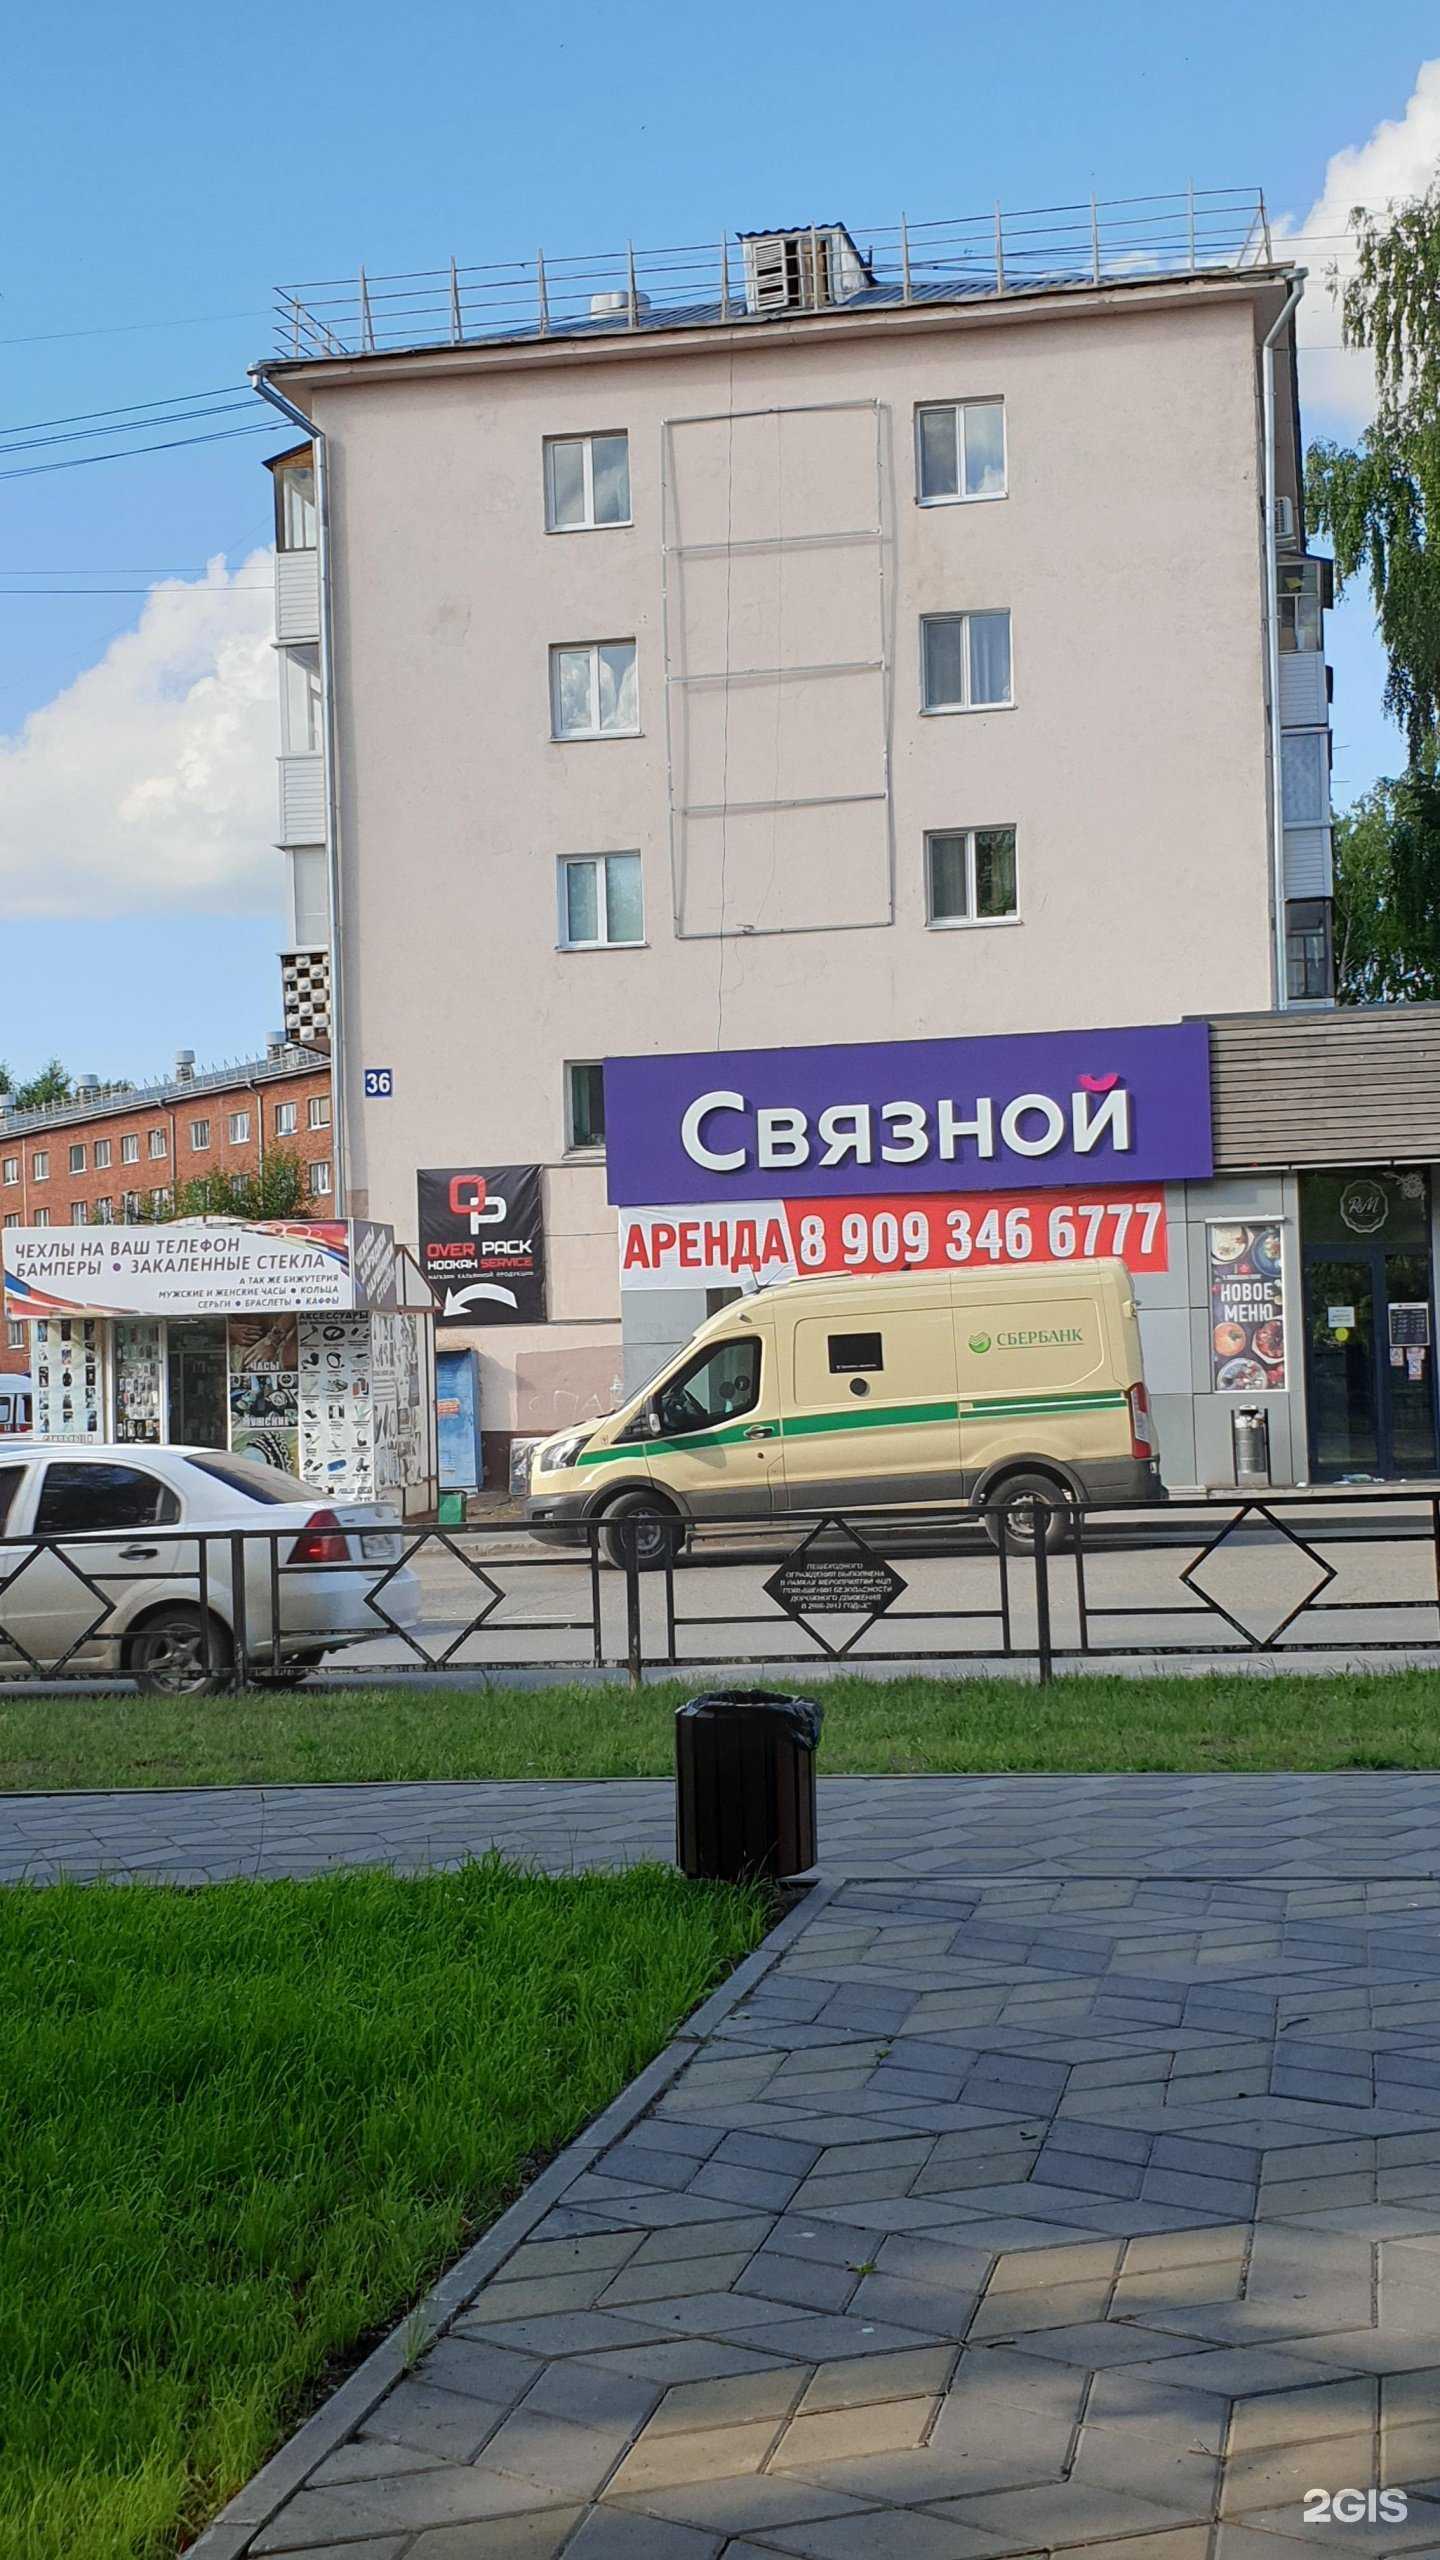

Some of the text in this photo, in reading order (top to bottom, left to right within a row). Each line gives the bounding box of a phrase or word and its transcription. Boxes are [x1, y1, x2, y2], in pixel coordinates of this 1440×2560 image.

[366, 1072, 391, 1094] 36
[622, 1201, 1163, 1274] АРЕНДА 8 909 346 6777
[15, 1237, 240, 1259] ЧЕХЛЫ НА ВАШ ТЕЛЕФОН
[426, 1239, 533, 1258] OVER PACK
[16, 1253, 326, 1278] БАМПЕРЫ ЗАКАЛЕННЫЕ СТЕКЛА
[427, 1256, 533, 1271] HOOKAH SERVICE
[239, 1273, 339, 1285] А ТАК ЖЕ БИЖУТЕРИЯ
[158, 1285, 339, 1299] МУЖСКИЕ И ЖЕНСКИЕ ЧАСЫ КОЛЬЦА
[1220, 1282, 1274, 1302] НОВОЕ
[198, 1296, 340, 1309] СЕРЬГИ БРАСЛЕТЫ КАФФЫ
[298, 1311, 369, 1321] АКСЕССУАРЫ
[1223, 1304, 1274, 1323] МЕНЮ
[996, 1327, 1084, 1346] СБЕРБАНК
[250, 1360, 280, 1371] ЧАСЫ
